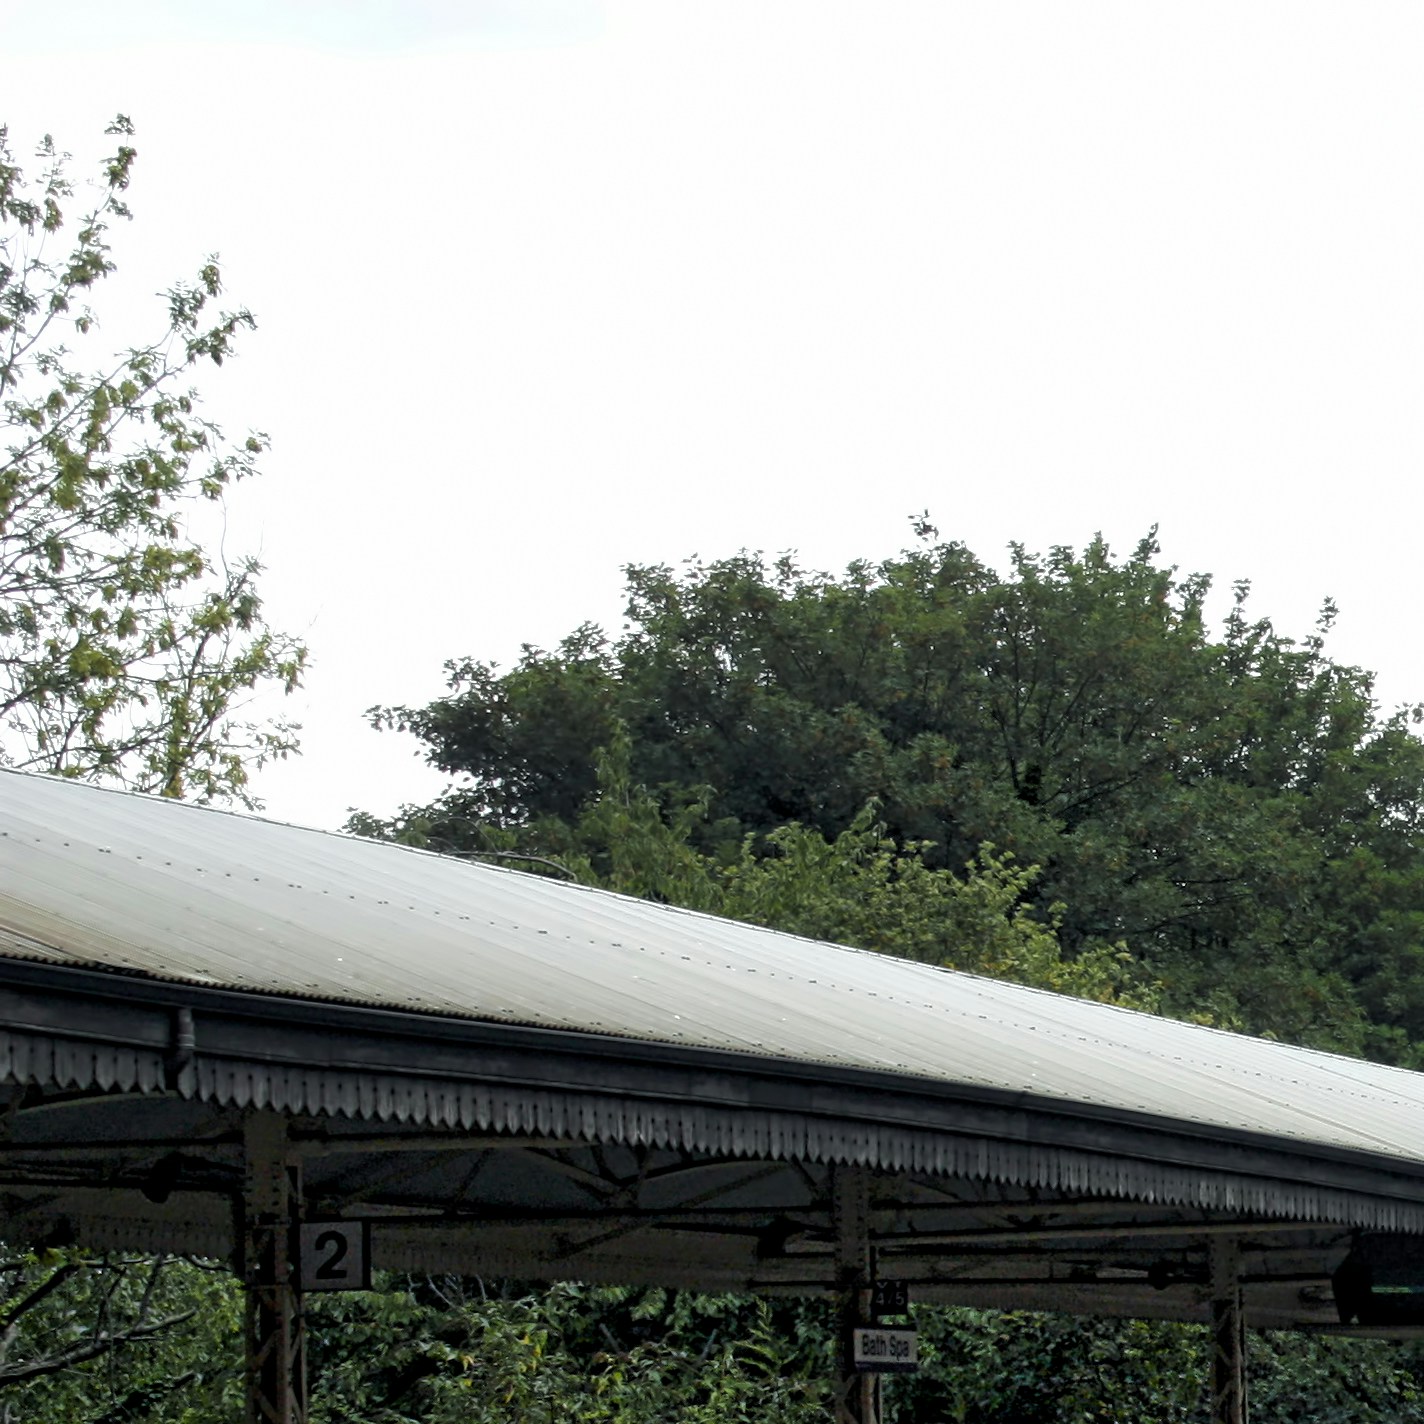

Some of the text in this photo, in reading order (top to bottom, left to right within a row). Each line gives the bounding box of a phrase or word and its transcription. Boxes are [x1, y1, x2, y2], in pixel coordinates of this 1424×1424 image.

[315, 1230, 348, 1280] 2
[875, 1291, 905, 1306] 4/5
[862, 1334, 909, 1361] Bath Spa
